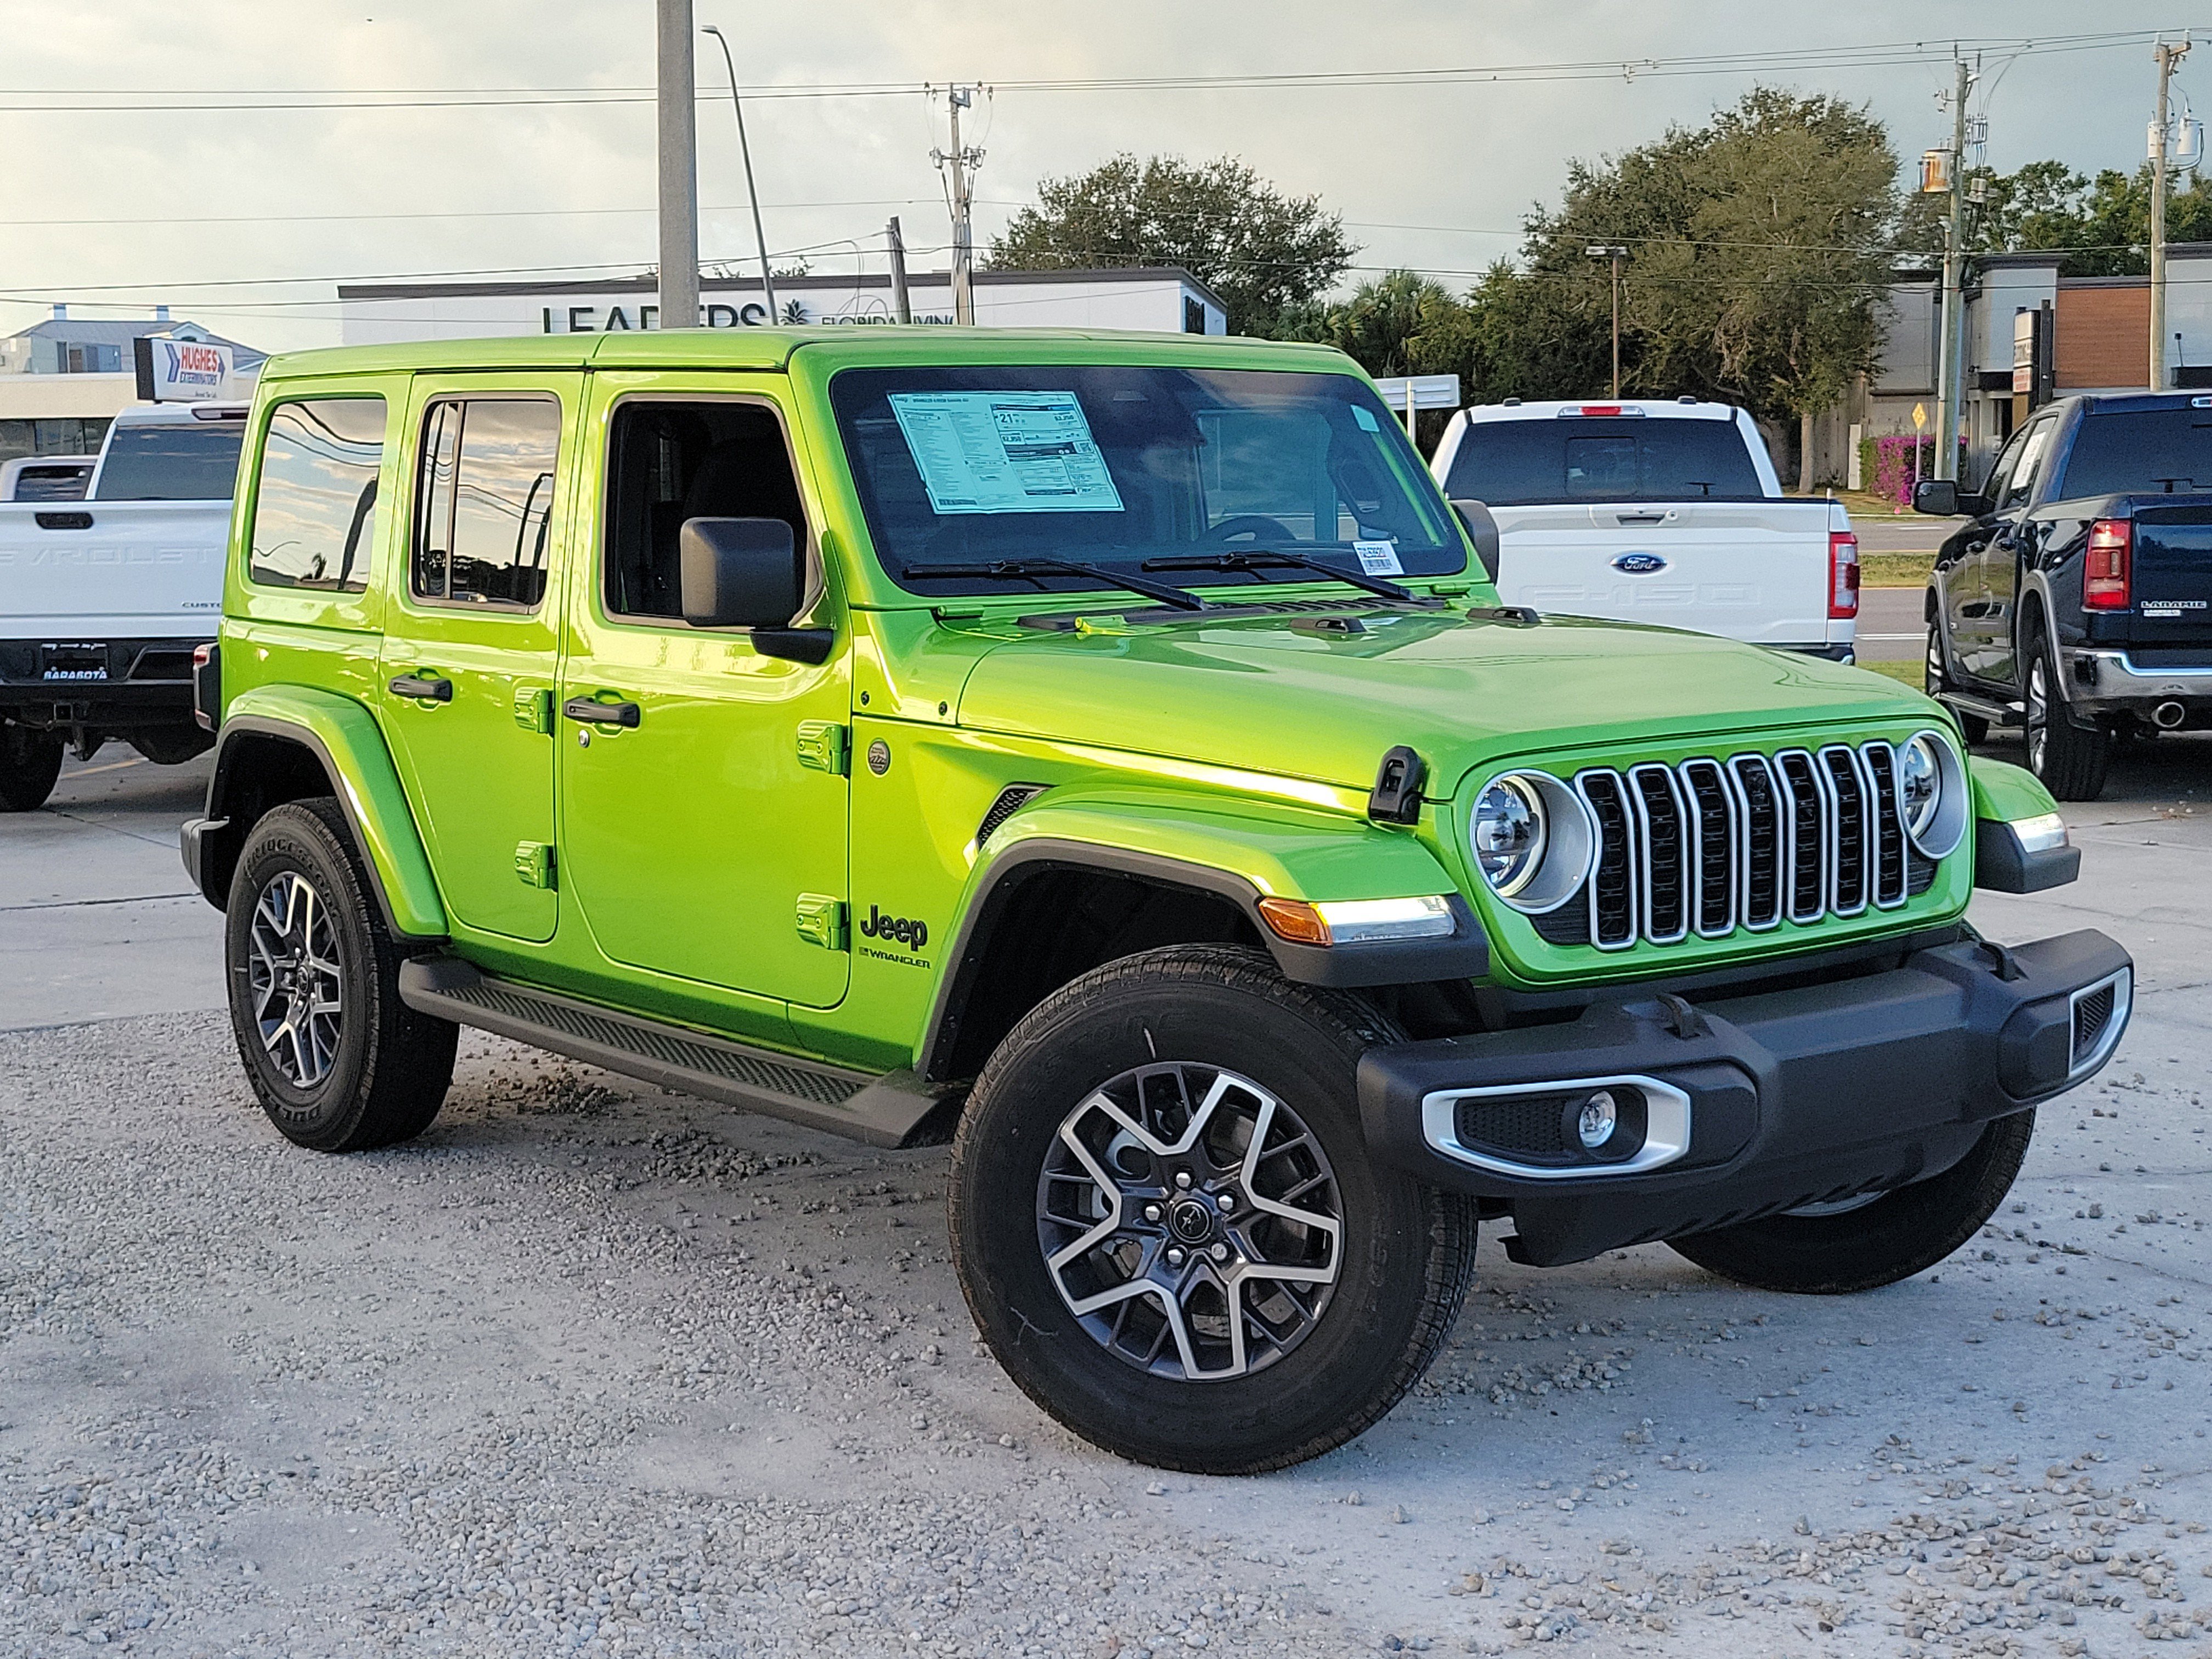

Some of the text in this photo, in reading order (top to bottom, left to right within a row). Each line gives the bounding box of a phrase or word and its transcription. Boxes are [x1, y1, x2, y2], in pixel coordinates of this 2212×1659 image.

[543, 303, 766, 334] LEARS
[181, 346, 218, 372] HUGHES
[1000, 414, 1013, 423] 21
[1624, 556, 1655, 569] Ford
[1519, 583, 1760, 606] F-150
[2141, 600, 2207, 609] LARAMIE
[43, 670, 108, 680] SARASOTA
[860, 904, 928, 952] Jeep
[869, 948, 931, 969] WRANGLER
